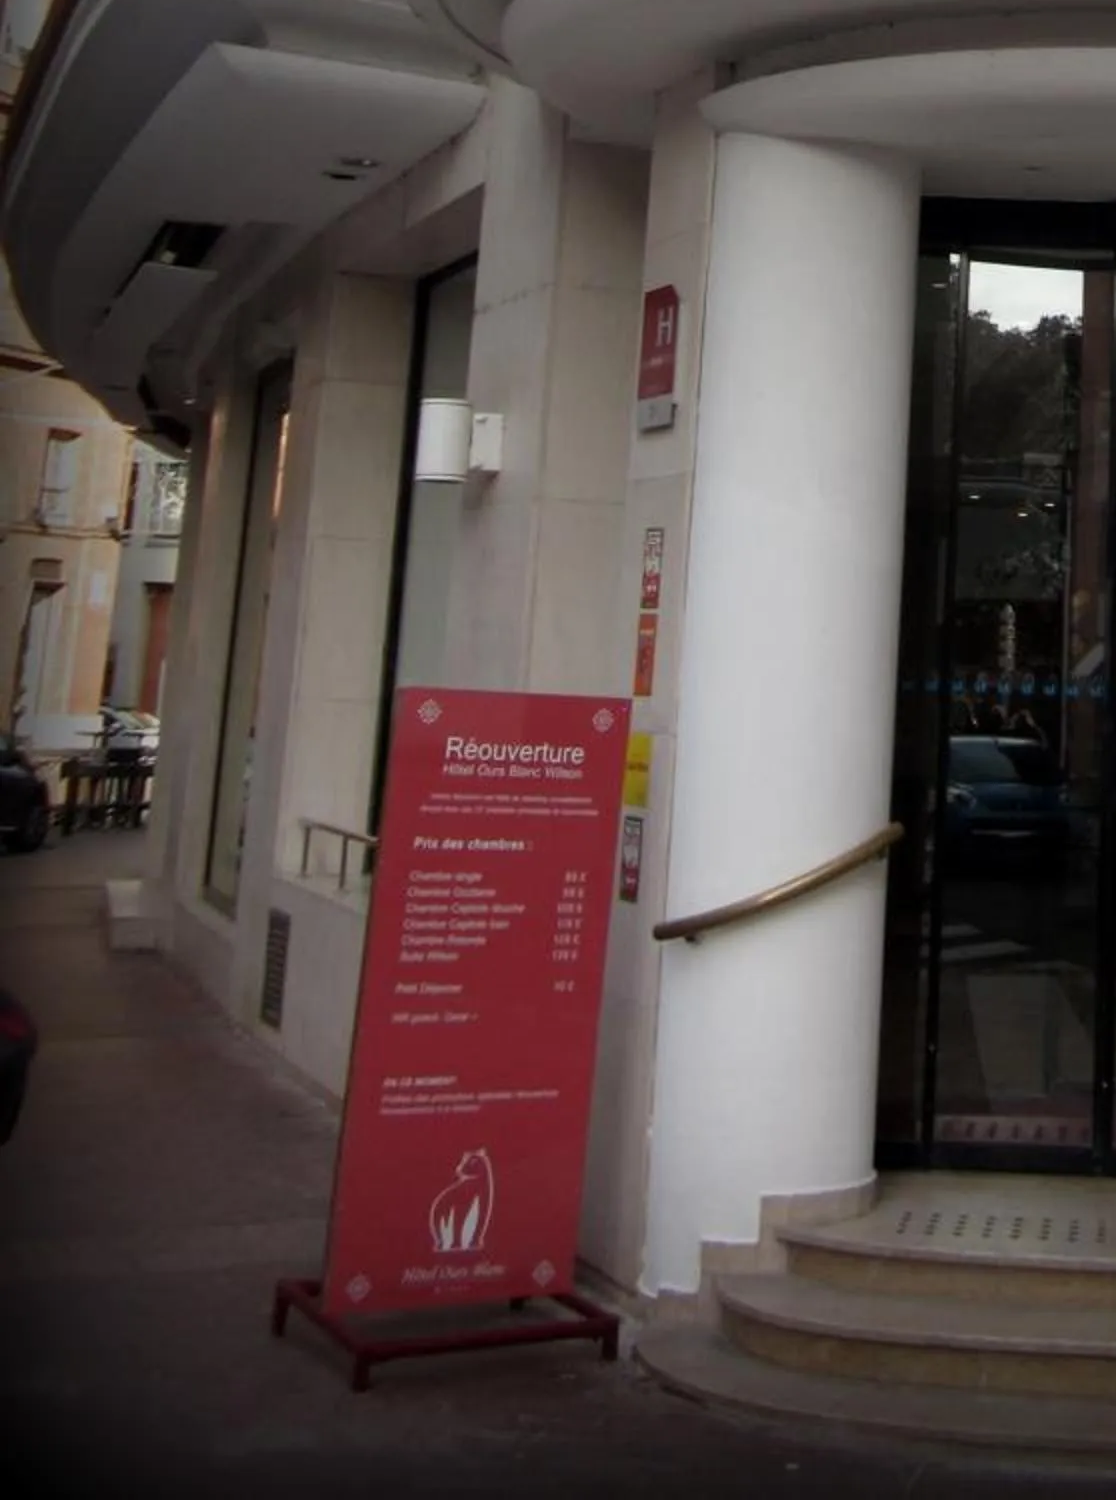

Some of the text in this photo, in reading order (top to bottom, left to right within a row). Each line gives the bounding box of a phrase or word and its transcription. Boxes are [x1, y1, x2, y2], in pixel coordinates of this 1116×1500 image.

[654, 304, 674, 347] H
[445, 736, 585, 764] Réouverture
[413, 836, 439, 850] Prix
[442, 838, 463, 850] des
